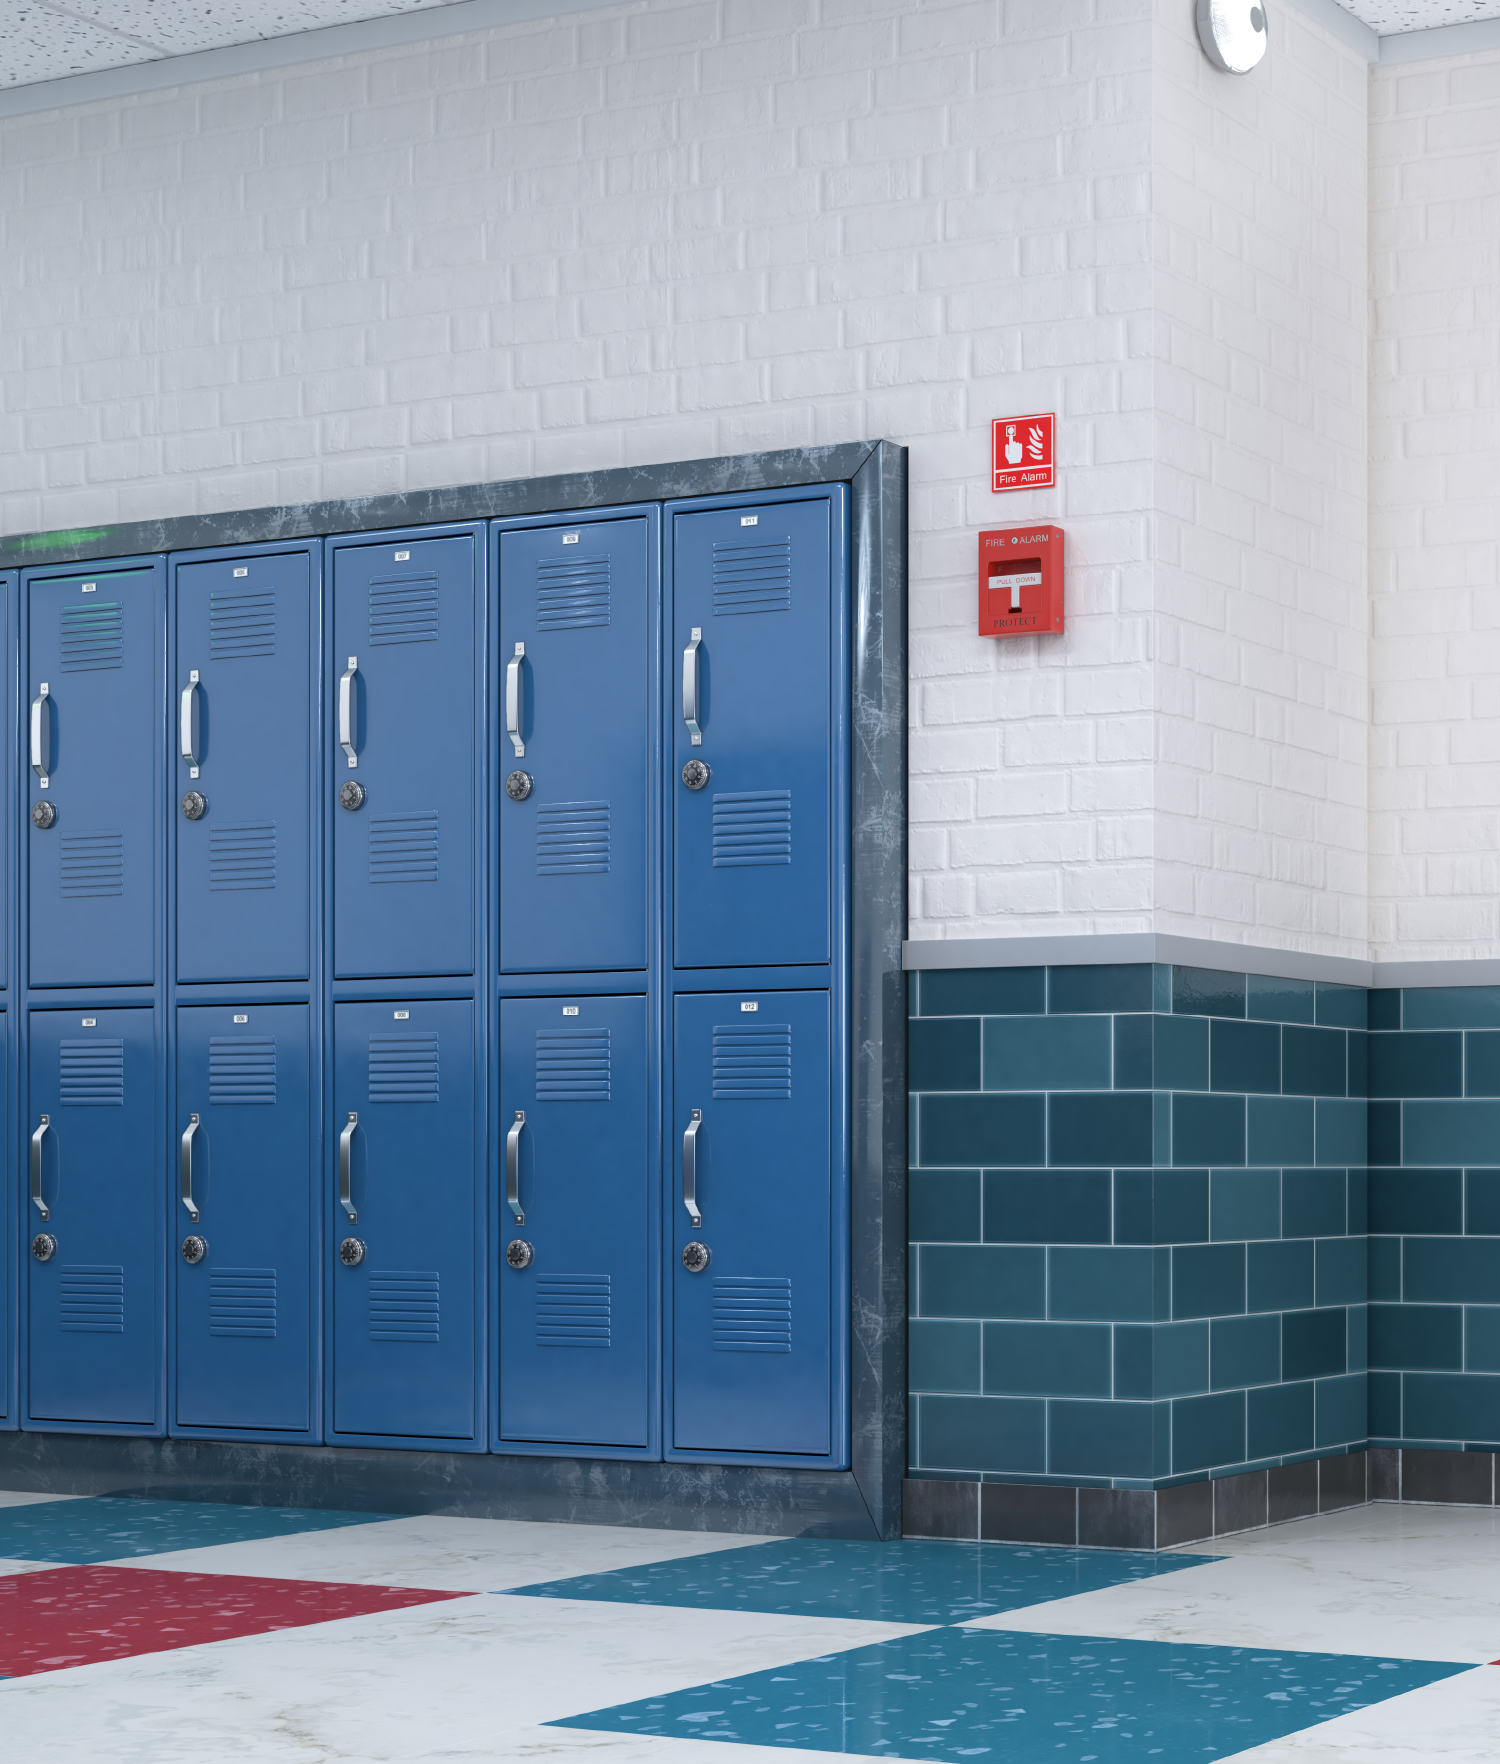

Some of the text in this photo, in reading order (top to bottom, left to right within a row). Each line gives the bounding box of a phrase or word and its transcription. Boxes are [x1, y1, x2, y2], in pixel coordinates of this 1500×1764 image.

[999, 472, 1048, 484] Fire Alarm
[985, 534, 1049, 548] FIRE ALARM
[996, 577, 1012, 585] PULL
[993, 616, 1038, 628] PROTECT
